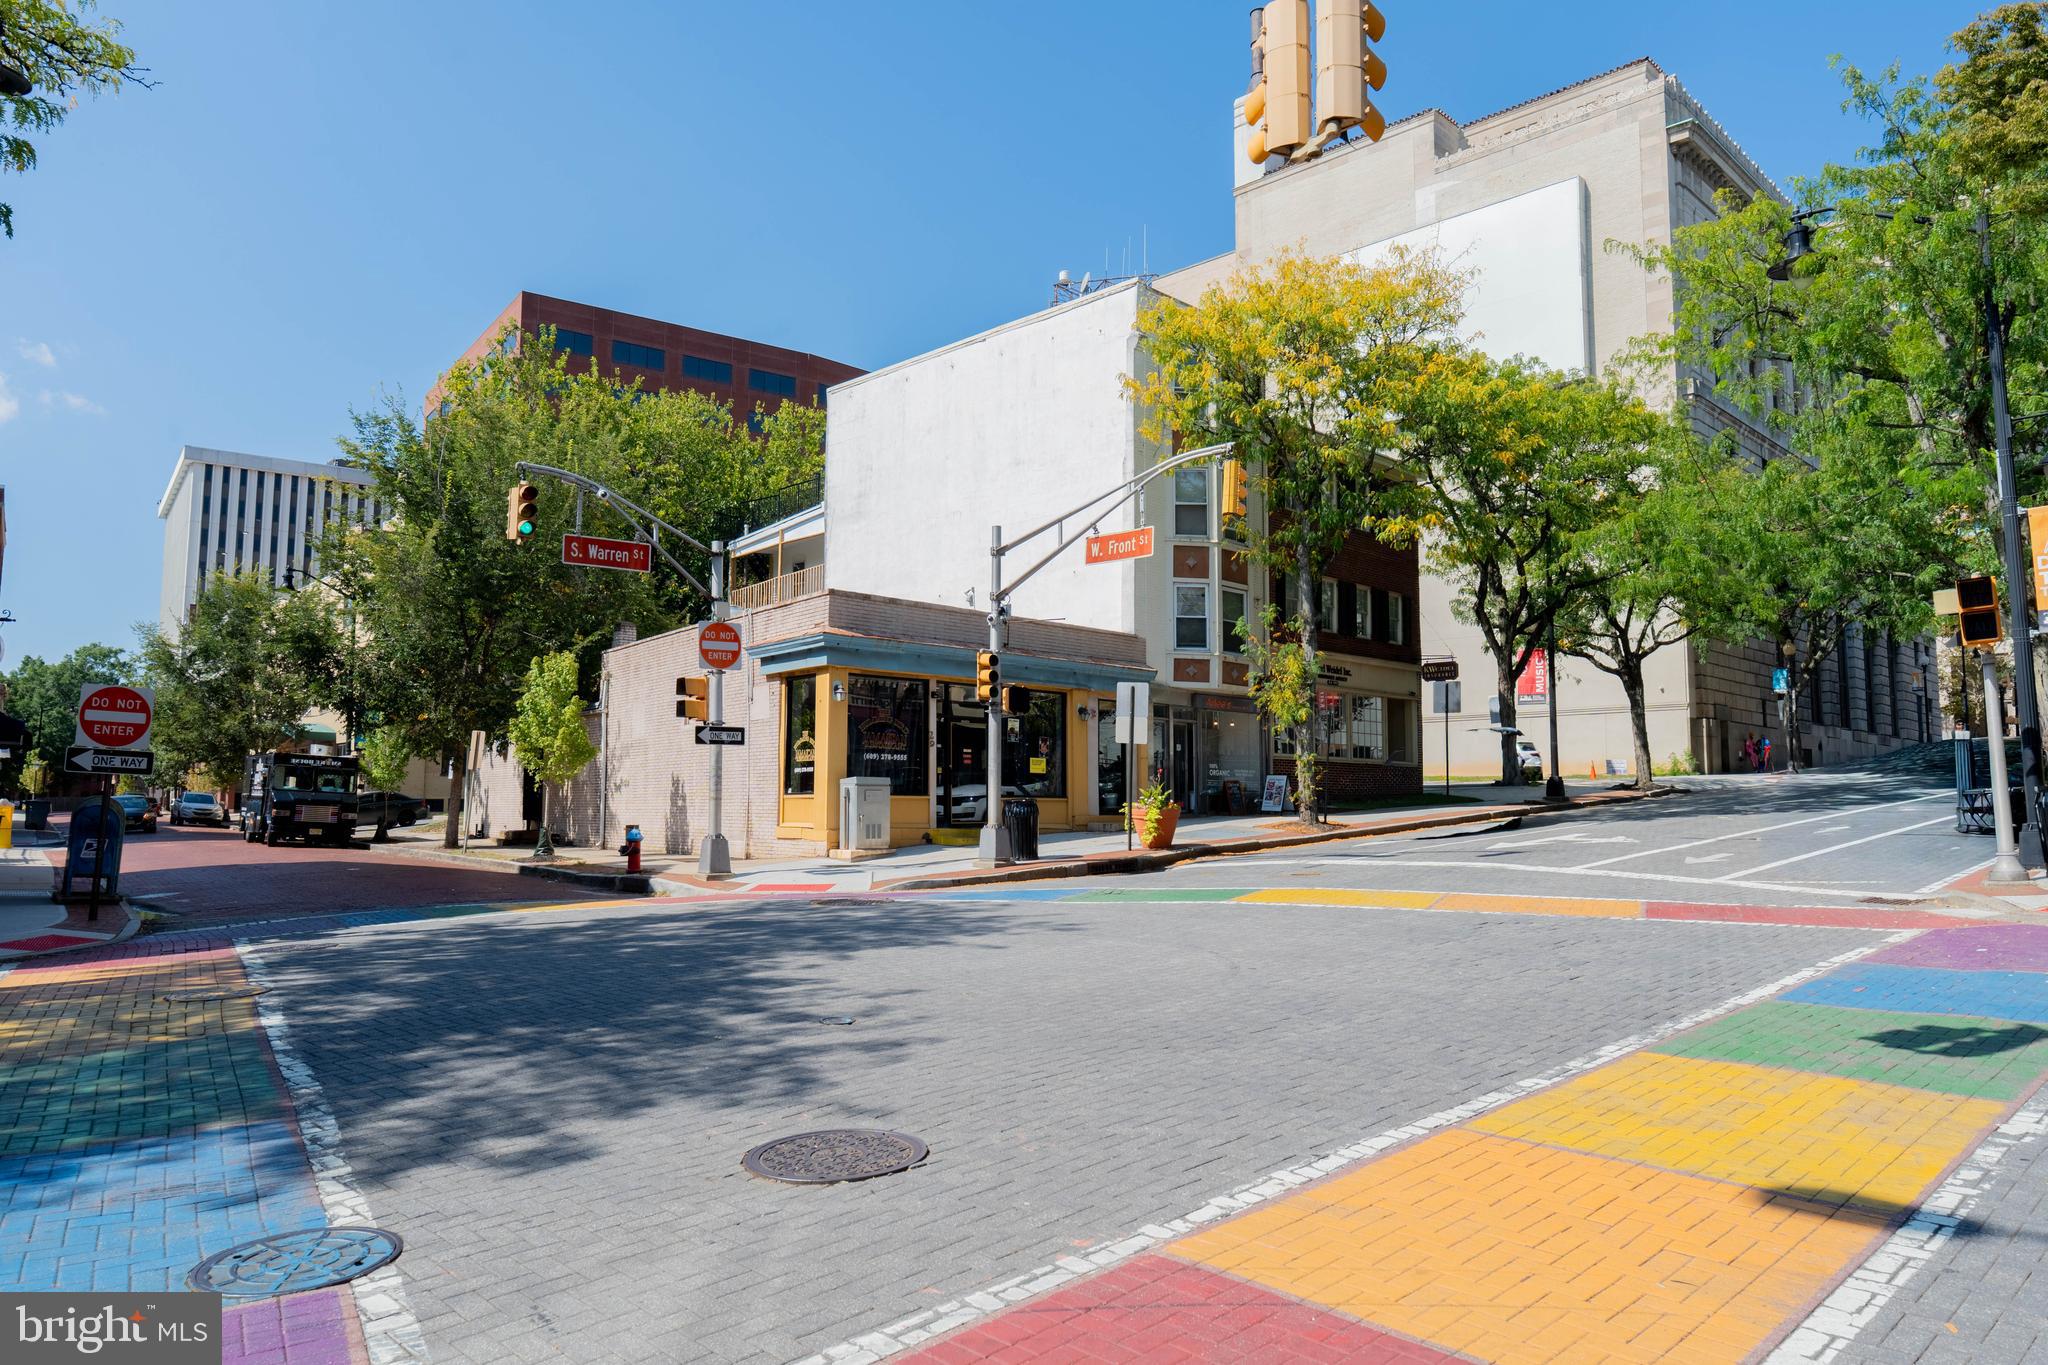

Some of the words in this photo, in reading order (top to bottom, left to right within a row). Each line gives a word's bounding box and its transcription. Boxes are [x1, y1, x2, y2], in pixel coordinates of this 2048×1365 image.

[1091, 542, 1103, 557] W.
[1108, 537, 1136, 555] Front
[1139, 535, 1148, 544] St
[570, 542, 583, 558] S.
[588, 543, 629, 563] Warren
[633, 549, 644, 560] St
[704, 631, 716, 639] DO
[720, 632, 735, 640] NOT
[708, 651, 733, 660] ENTER
[1535, 657, 1545, 693] MUSIC
[91, 697, 109, 708] DO
[117, 699, 142, 710] NOT
[94, 725, 134, 736] ENTER
[710, 731, 723, 740] ONE
[726, 732, 740, 740] WAY
[92, 755, 117, 766] ONE
[120, 757, 145, 768] WAY
[1208, 769, 1231, 777] ORGANIC
